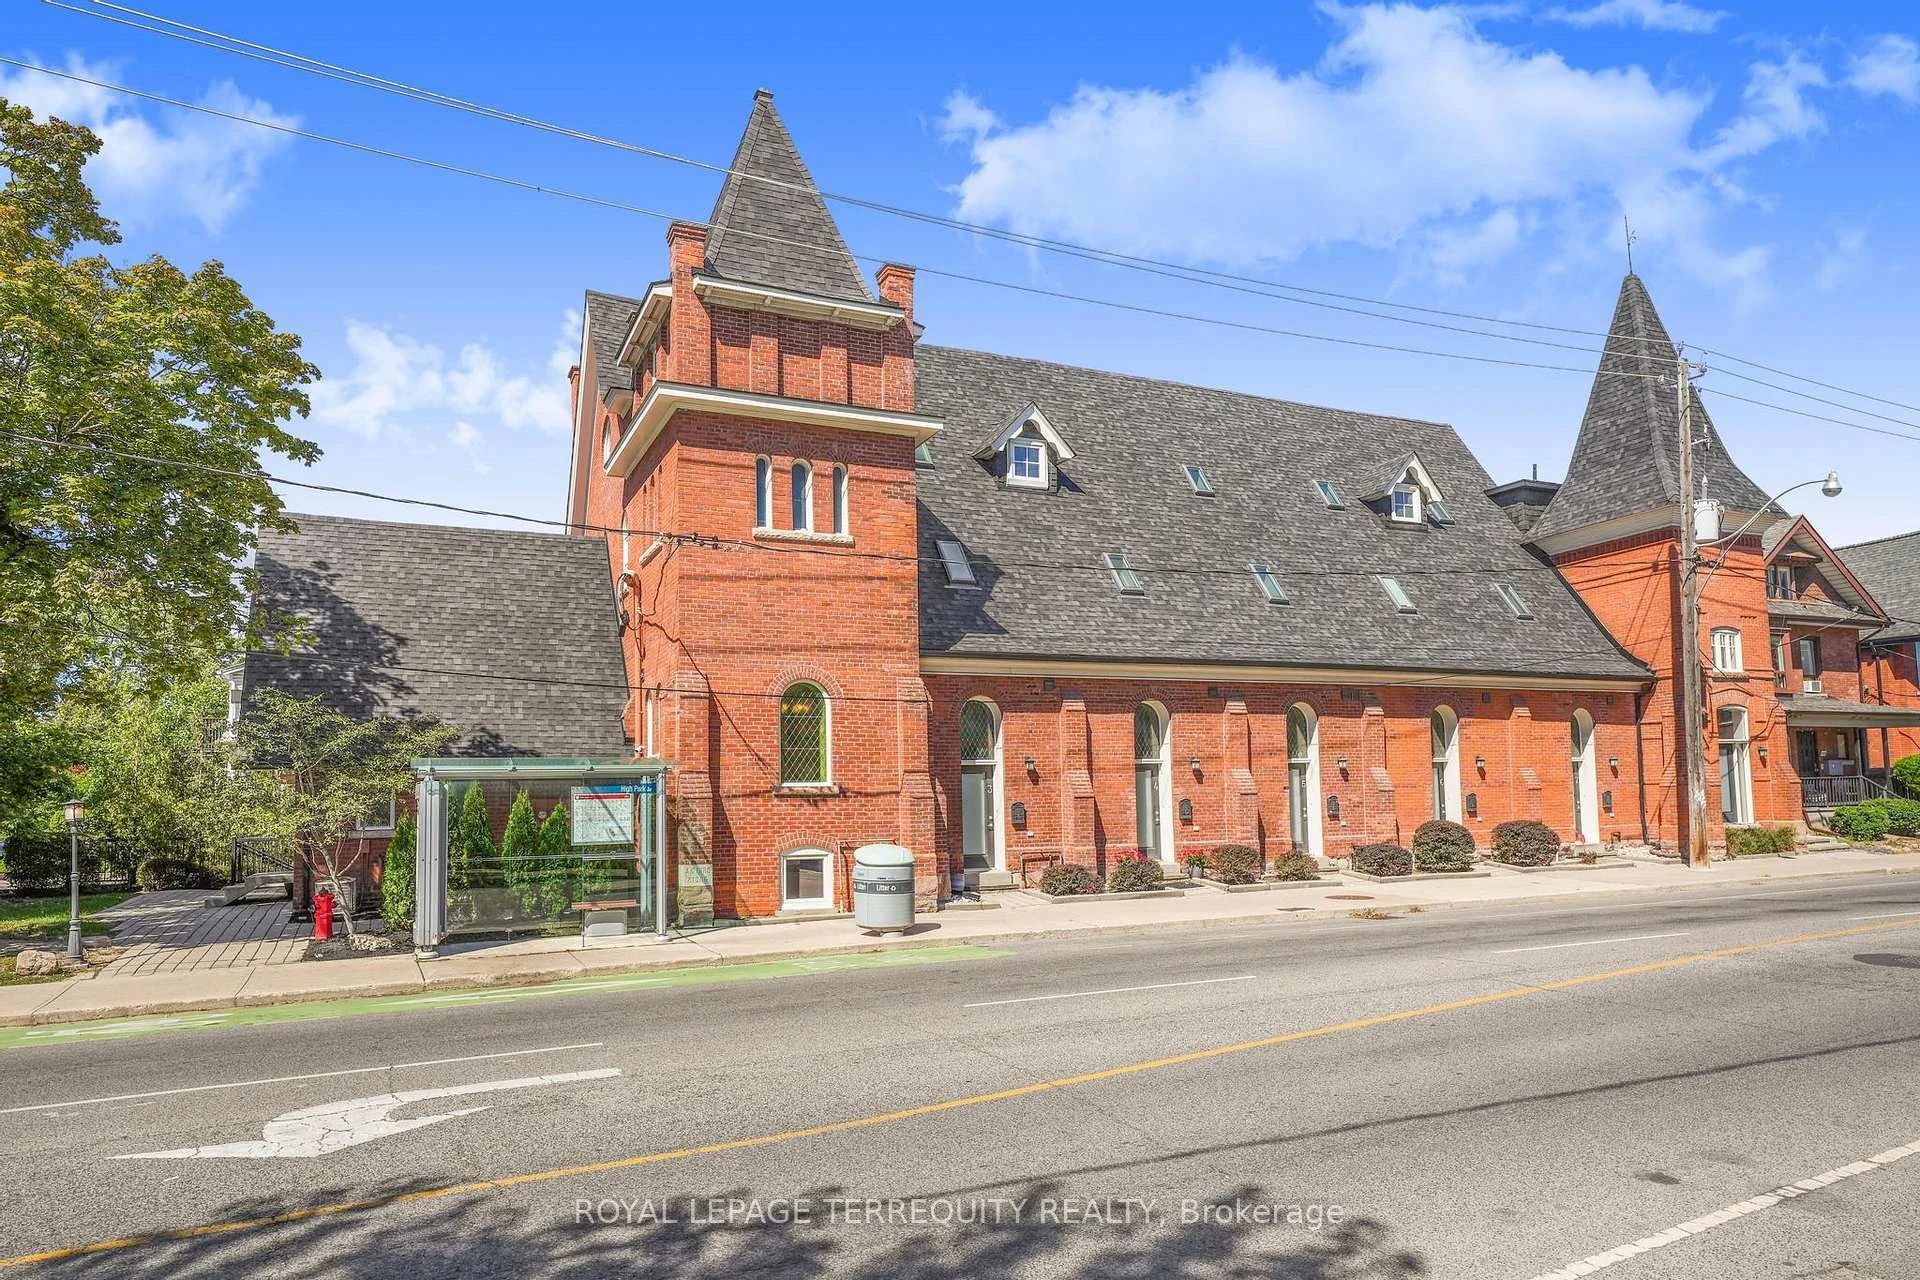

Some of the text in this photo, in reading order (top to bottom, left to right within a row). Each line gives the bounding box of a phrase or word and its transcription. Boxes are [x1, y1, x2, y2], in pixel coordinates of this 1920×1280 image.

[620, 784, 633, 793] High
[634, 784, 646, 792] Park
[986, 784, 993, 794] 3
